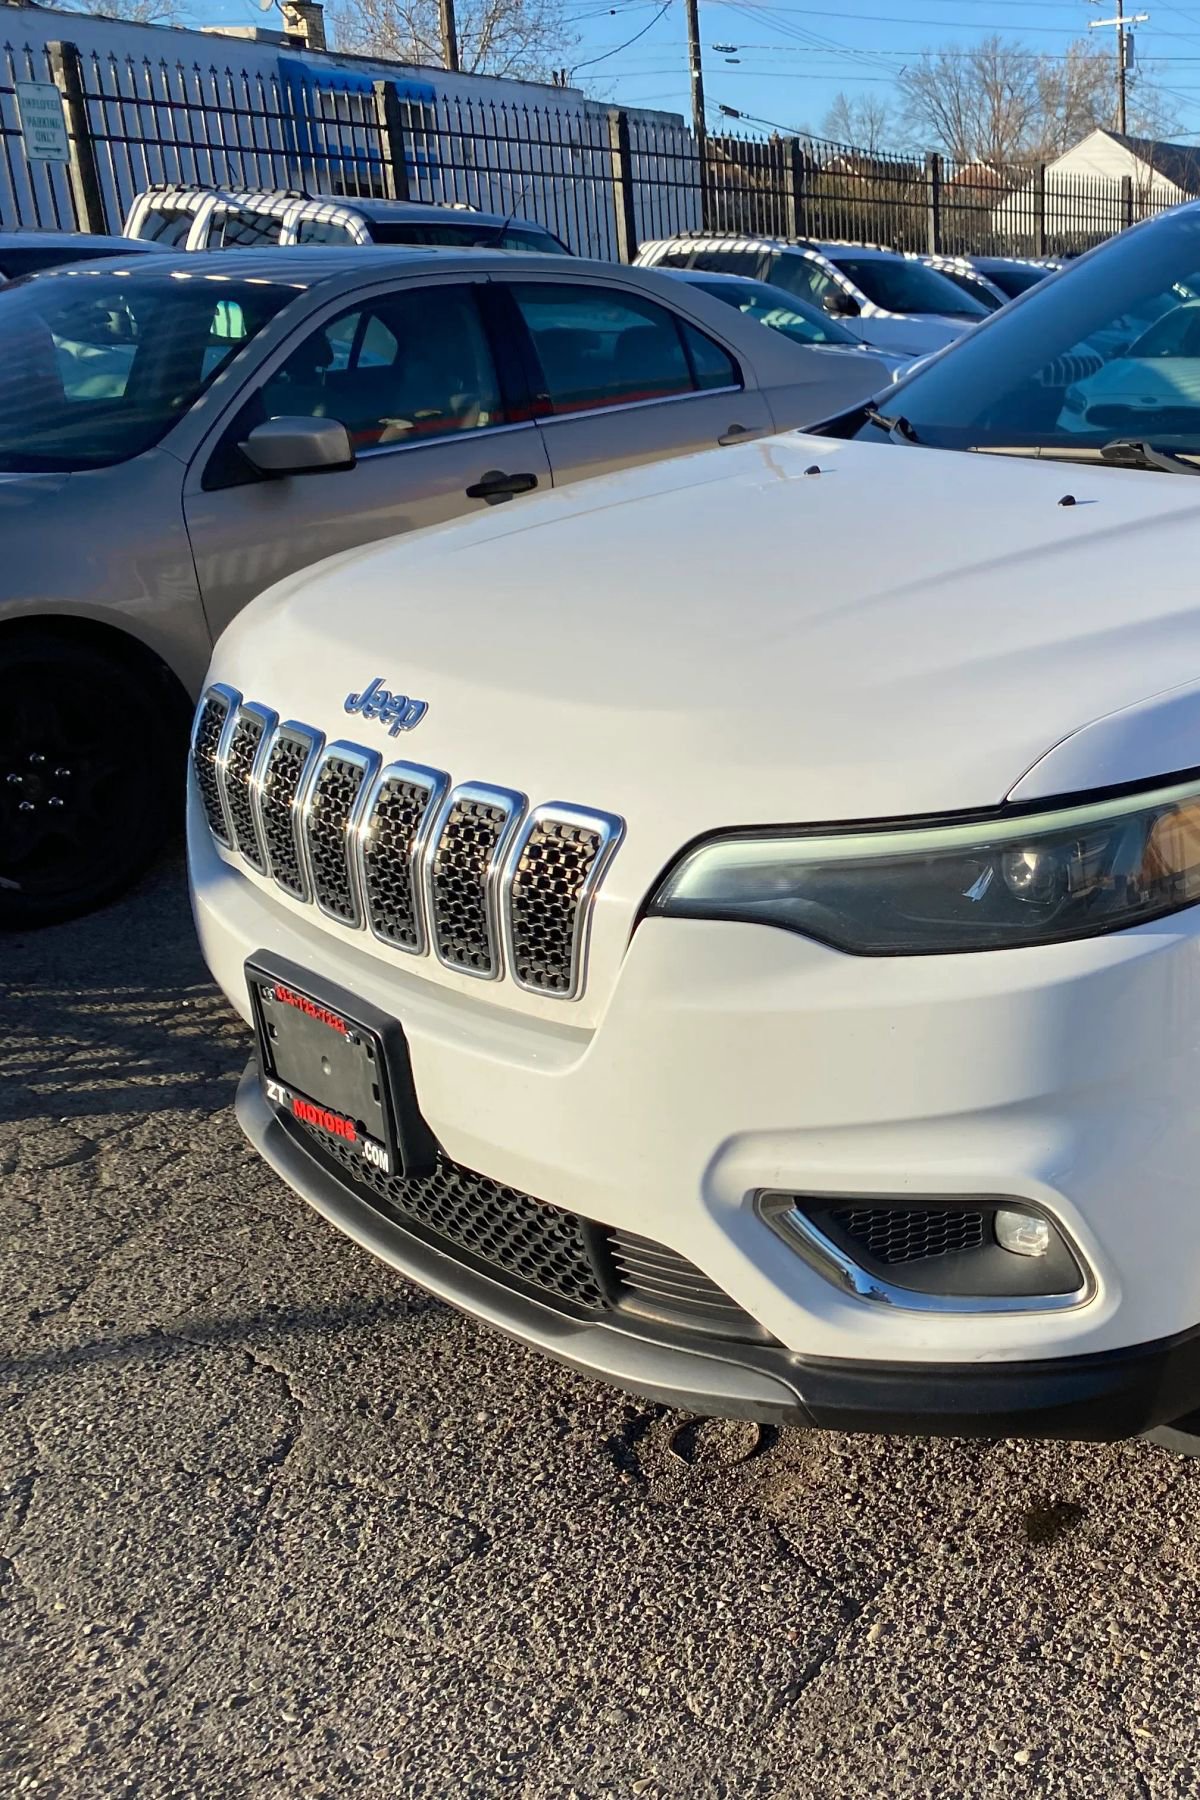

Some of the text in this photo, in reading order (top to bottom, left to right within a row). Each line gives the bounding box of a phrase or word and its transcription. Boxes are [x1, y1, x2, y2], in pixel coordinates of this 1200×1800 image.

[26, 116, 61, 129] PARKING
[35, 130, 56, 143] ONLY
[343, 676, 429, 738] Jeep
[266, 1079, 389, 1174] ZT MOTORS .COM
